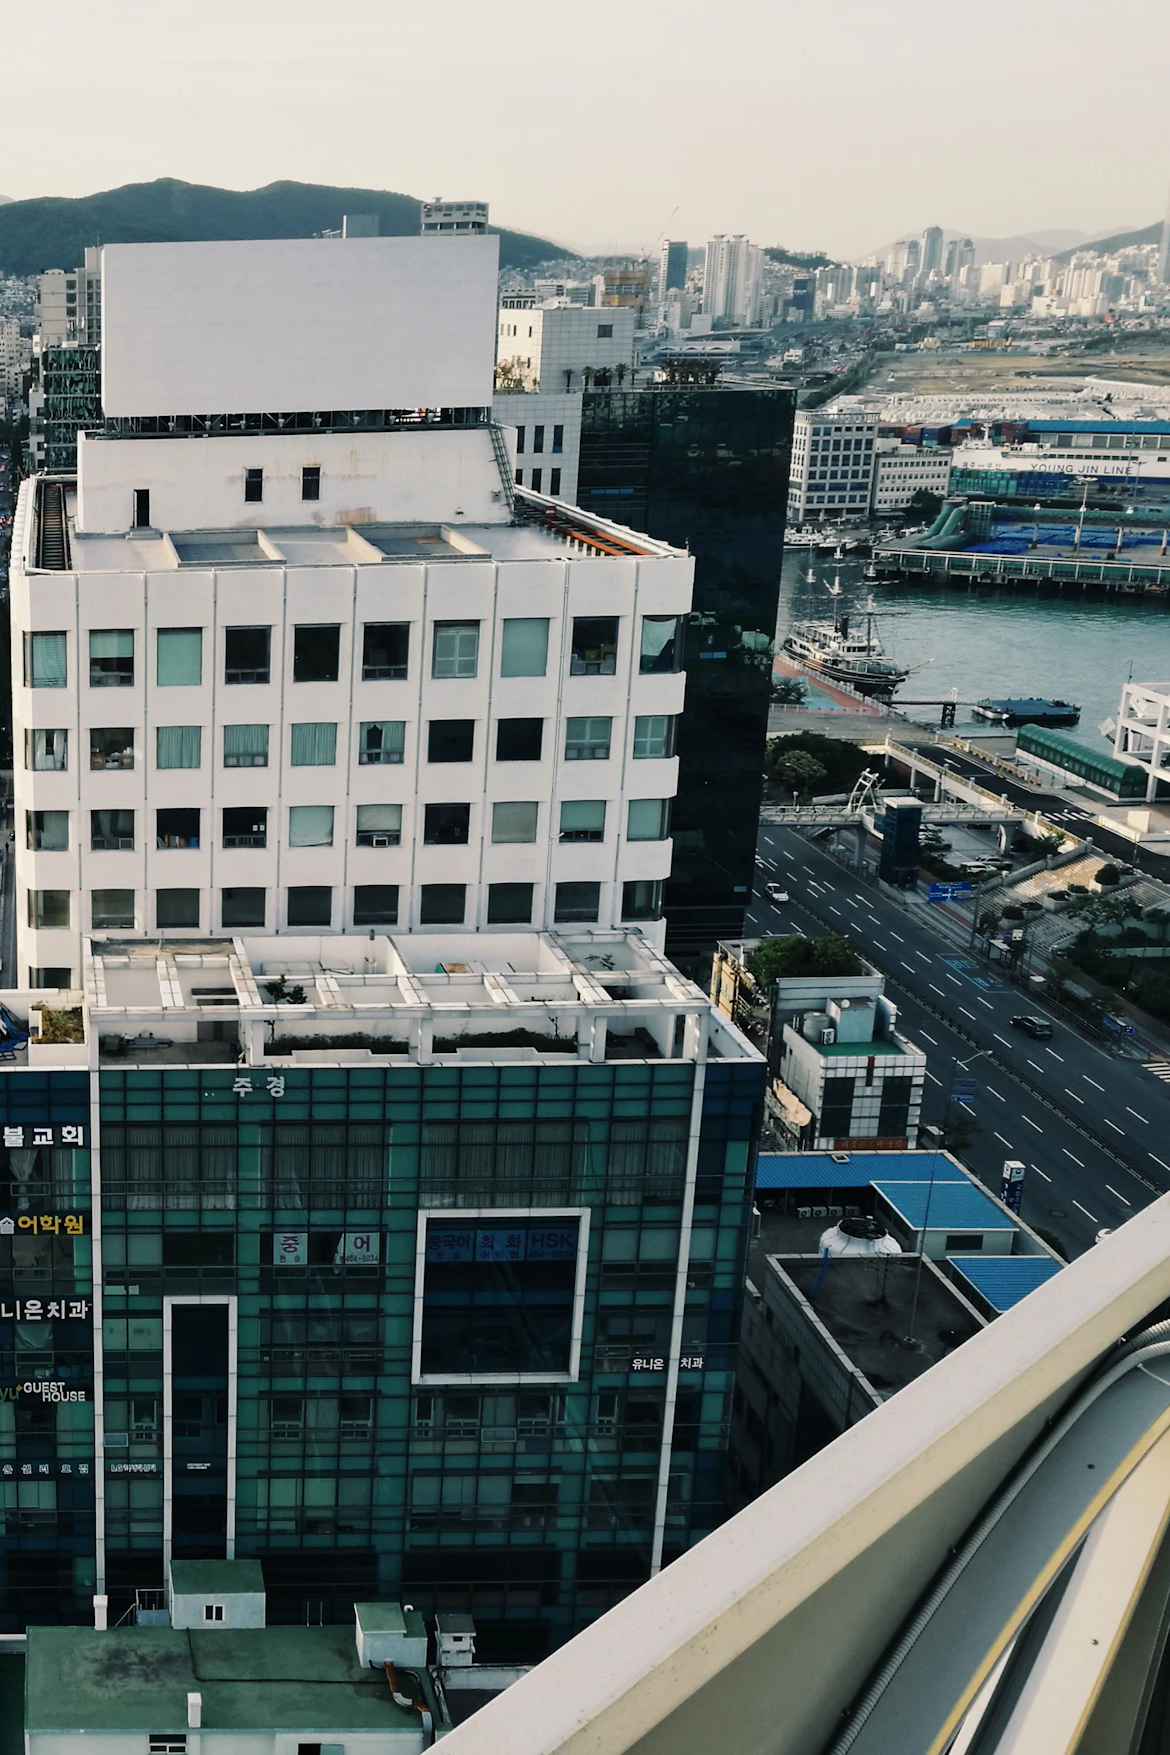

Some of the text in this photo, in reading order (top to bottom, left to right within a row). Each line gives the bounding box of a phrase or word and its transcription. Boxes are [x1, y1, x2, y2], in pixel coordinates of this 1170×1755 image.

[1030, 463, 1133, 475] YOUNG JIN LINE
[232, 1076, 285, 1097] 주경
[428, 1234, 470, 1250] 중국어
[531, 1232, 574, 1248] HSK
[632, 1357, 704, 1370] 유니온 치과
[24, 1382, 65, 1394] GUEST
[43, 1391, 86, 1402] HOUSE
